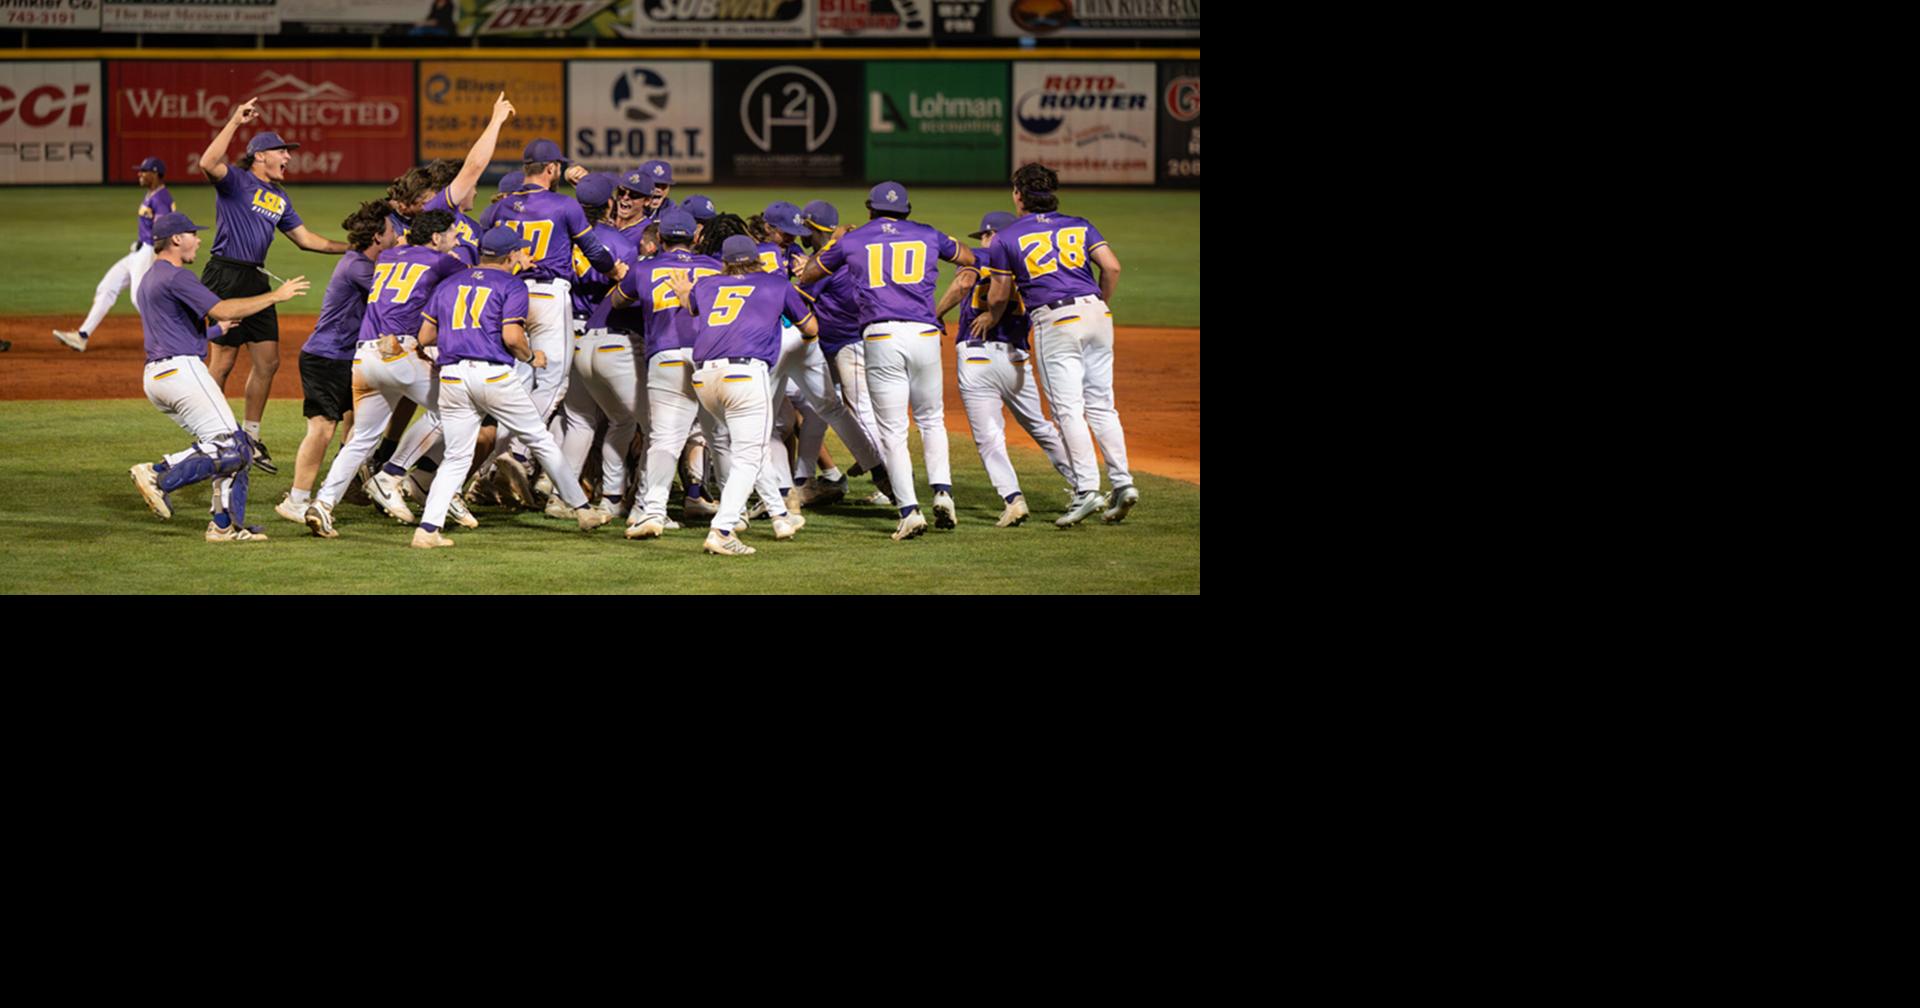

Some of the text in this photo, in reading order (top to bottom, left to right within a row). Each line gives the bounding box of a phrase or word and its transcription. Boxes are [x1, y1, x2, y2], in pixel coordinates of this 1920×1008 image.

[909, 91, 1002, 118] Lohman
[1039, 93, 1147, 110] ROOTER
[919, 120, 1002, 136] accounting
[865, 240, 927, 288] 10
[1018, 226, 1088, 279] 28
[452, 285, 493, 330] 11
[707, 286, 755, 327] 5
